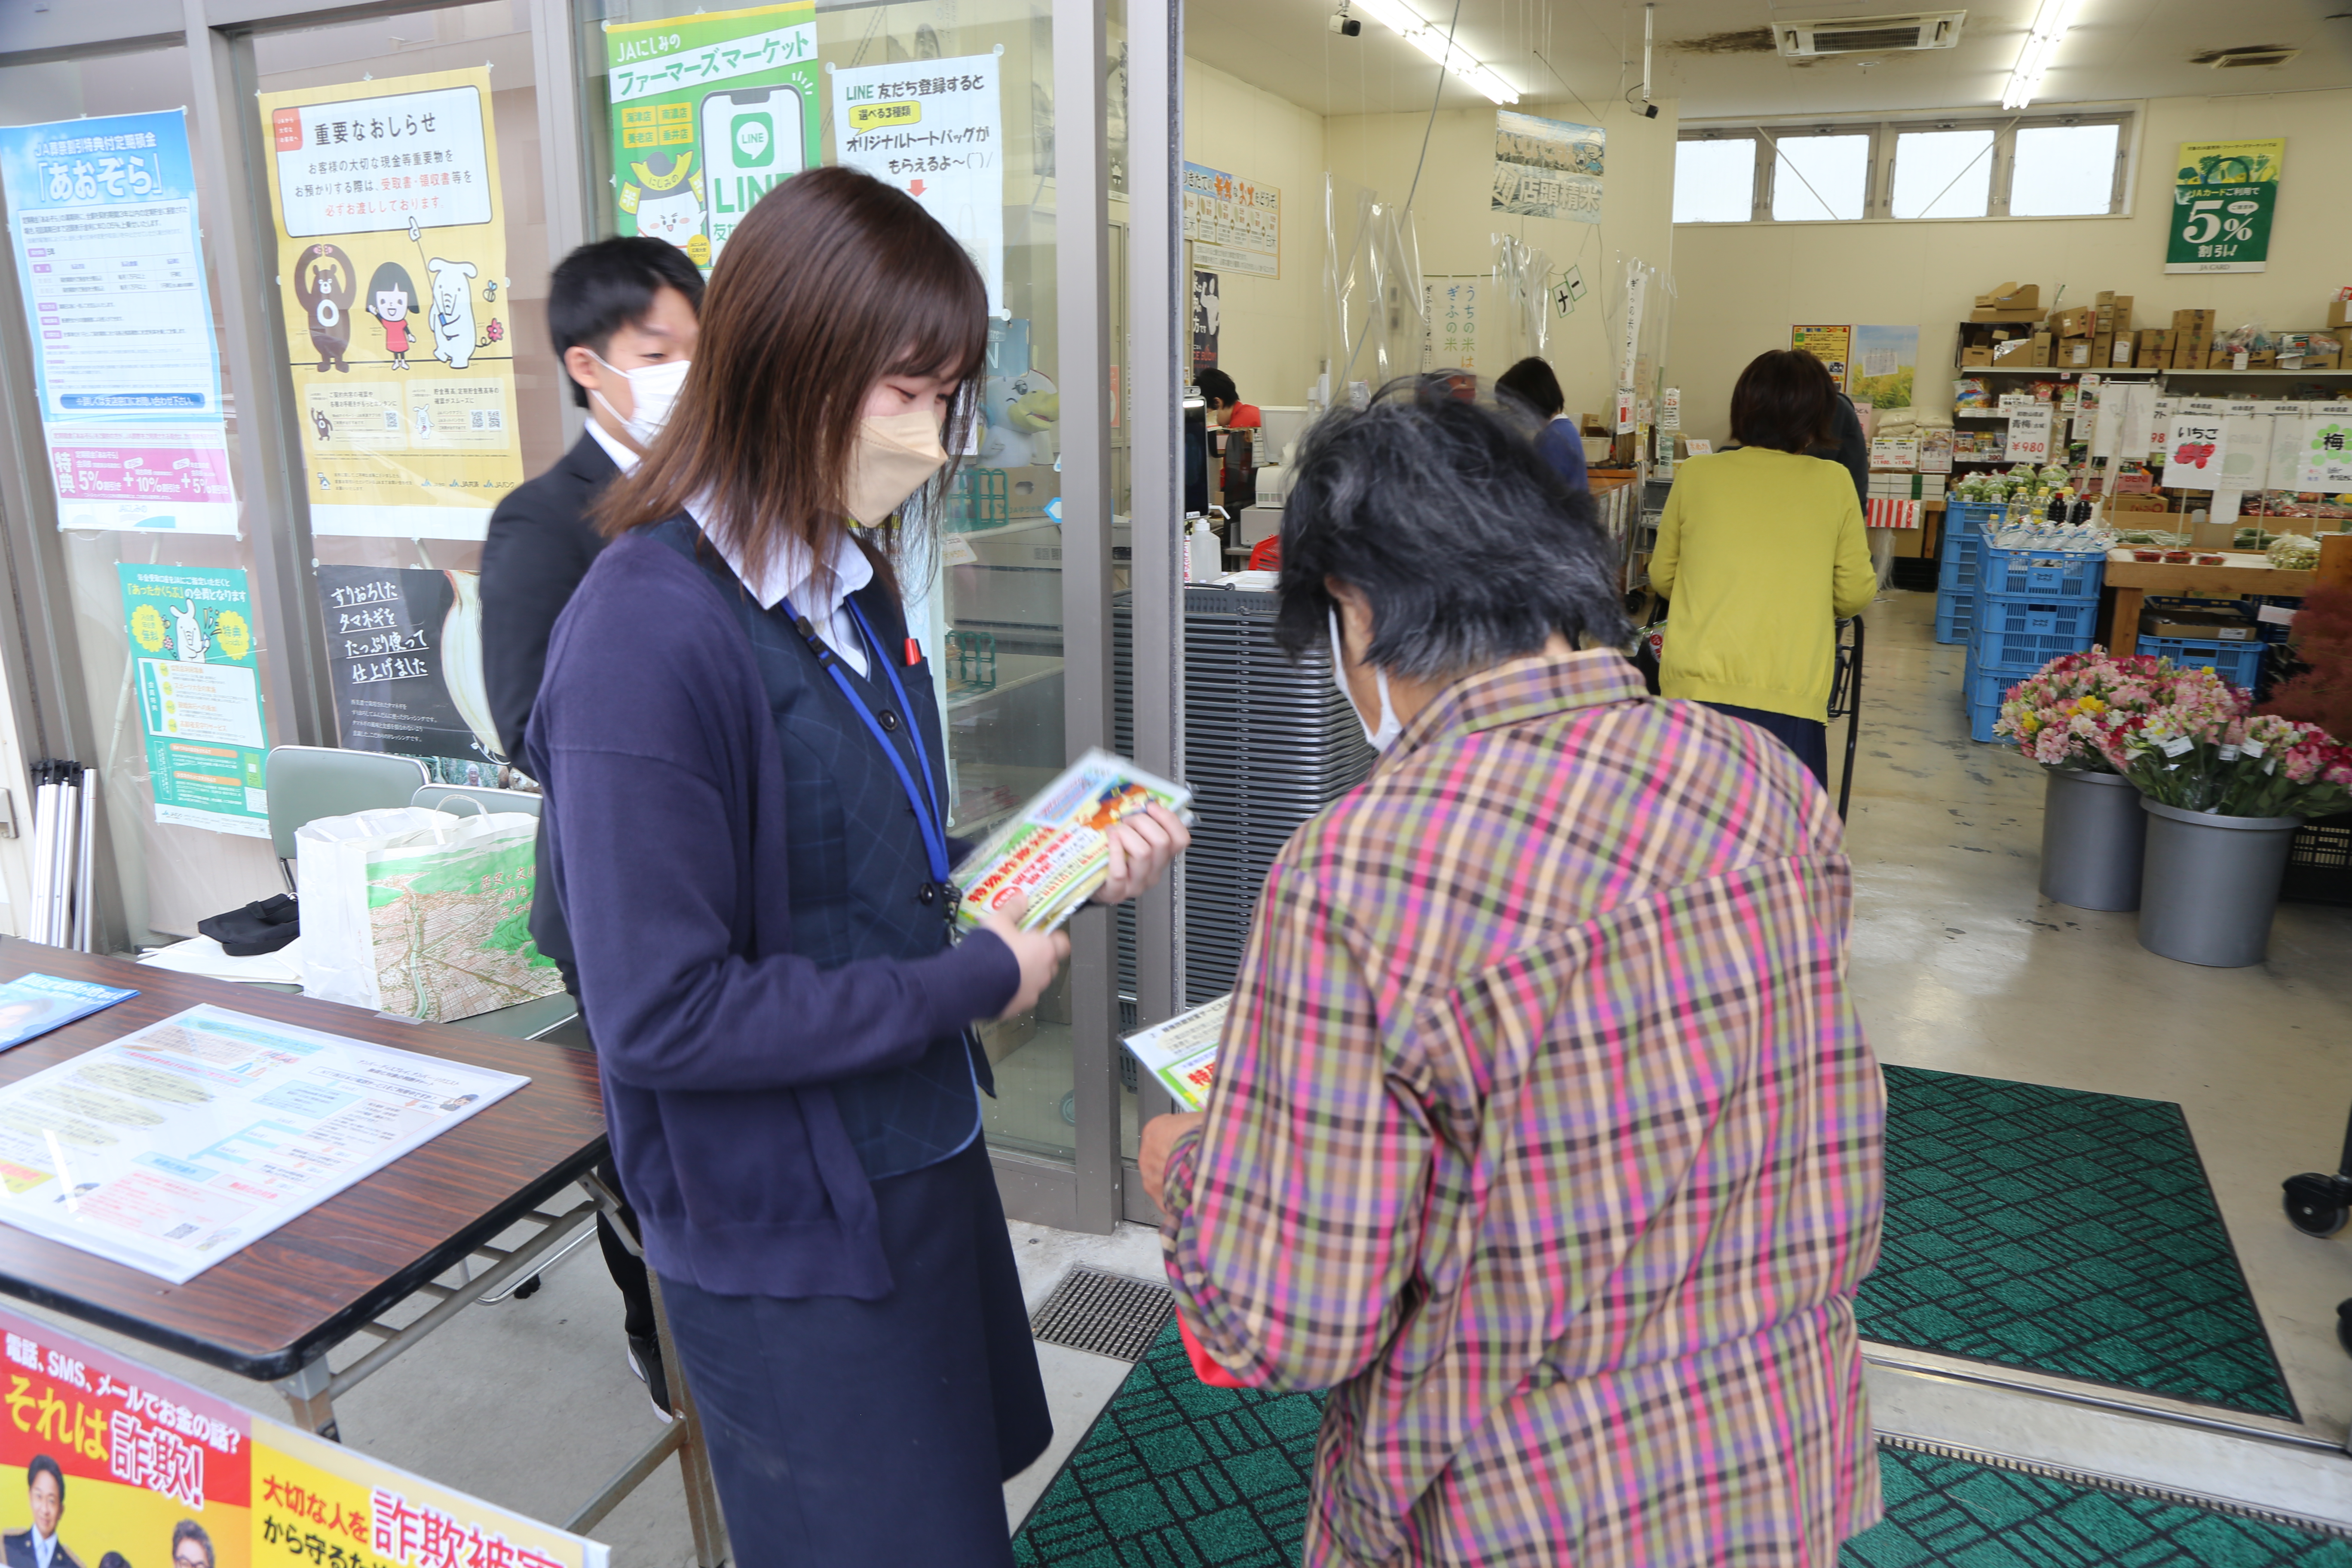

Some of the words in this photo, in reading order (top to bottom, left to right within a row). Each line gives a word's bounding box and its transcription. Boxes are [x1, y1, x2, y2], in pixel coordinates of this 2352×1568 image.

[617, 34, 681, 63] JAにしみの
[619, 31, 809, 95] ファーマーズマーケット
[846, 85, 874, 101] LINE
[878, 74, 984, 100] 友だち登録すると
[625, 110, 652, 122] 海津店
[662, 107, 688, 120] 南濃店
[858, 105, 912, 121] 選べる3種類
[314, 113, 436, 146] 重要なおしらせ
[627, 131, 653, 144] 養老店
[663, 128, 688, 140] 垂井店
[742, 133, 764, 144] LINE
[847, 126, 989, 152] オリジナルトートバッグが
[308, 149, 453, 175] お客様の大切な現金等重要物を
[38, 153, 162, 202] 「あおぞら」
[294, 170, 472, 198] お預かりする際は、受取書・領収書等を
[649, 174, 679, 189] にしみの
[715, 172, 795, 214] LIN
[1520, 176, 1600, 212] 店頭精米
[2191, 187, 2260, 197] JAカードご利用で
[325, 196, 444, 217] 必ずお渡ししております。
[2183, 200, 2254, 244] 5%
[1444, 285, 1460, 352] ぎふの米
[1461, 285, 1475, 368] うちの米は
[2012, 420, 2031, 428] 青梅
[2178, 427, 2219, 440] いちご
[2012, 441, 2045, 452] ¥980
[2324, 433, 2345, 450] 梅
[54, 452, 76, 494] 特典
[78, 471, 122, 491] 5%割引き
[136, 477, 181, 493] 10%割引き
[331, 581, 398, 606] すりおろした
[339, 607, 395, 631] タマネギを
[345, 629, 427, 656] たっぷり使って
[352, 657, 427, 682] 仕上げました
[5, 1332, 241, 1455] 電話、SMS、メールでお金の話?
[4, 1374, 204, 1512] それは詐欺!
[263, 1474, 370, 1544] 大切な人を
[263, 1515, 388, 1568] から守るた
